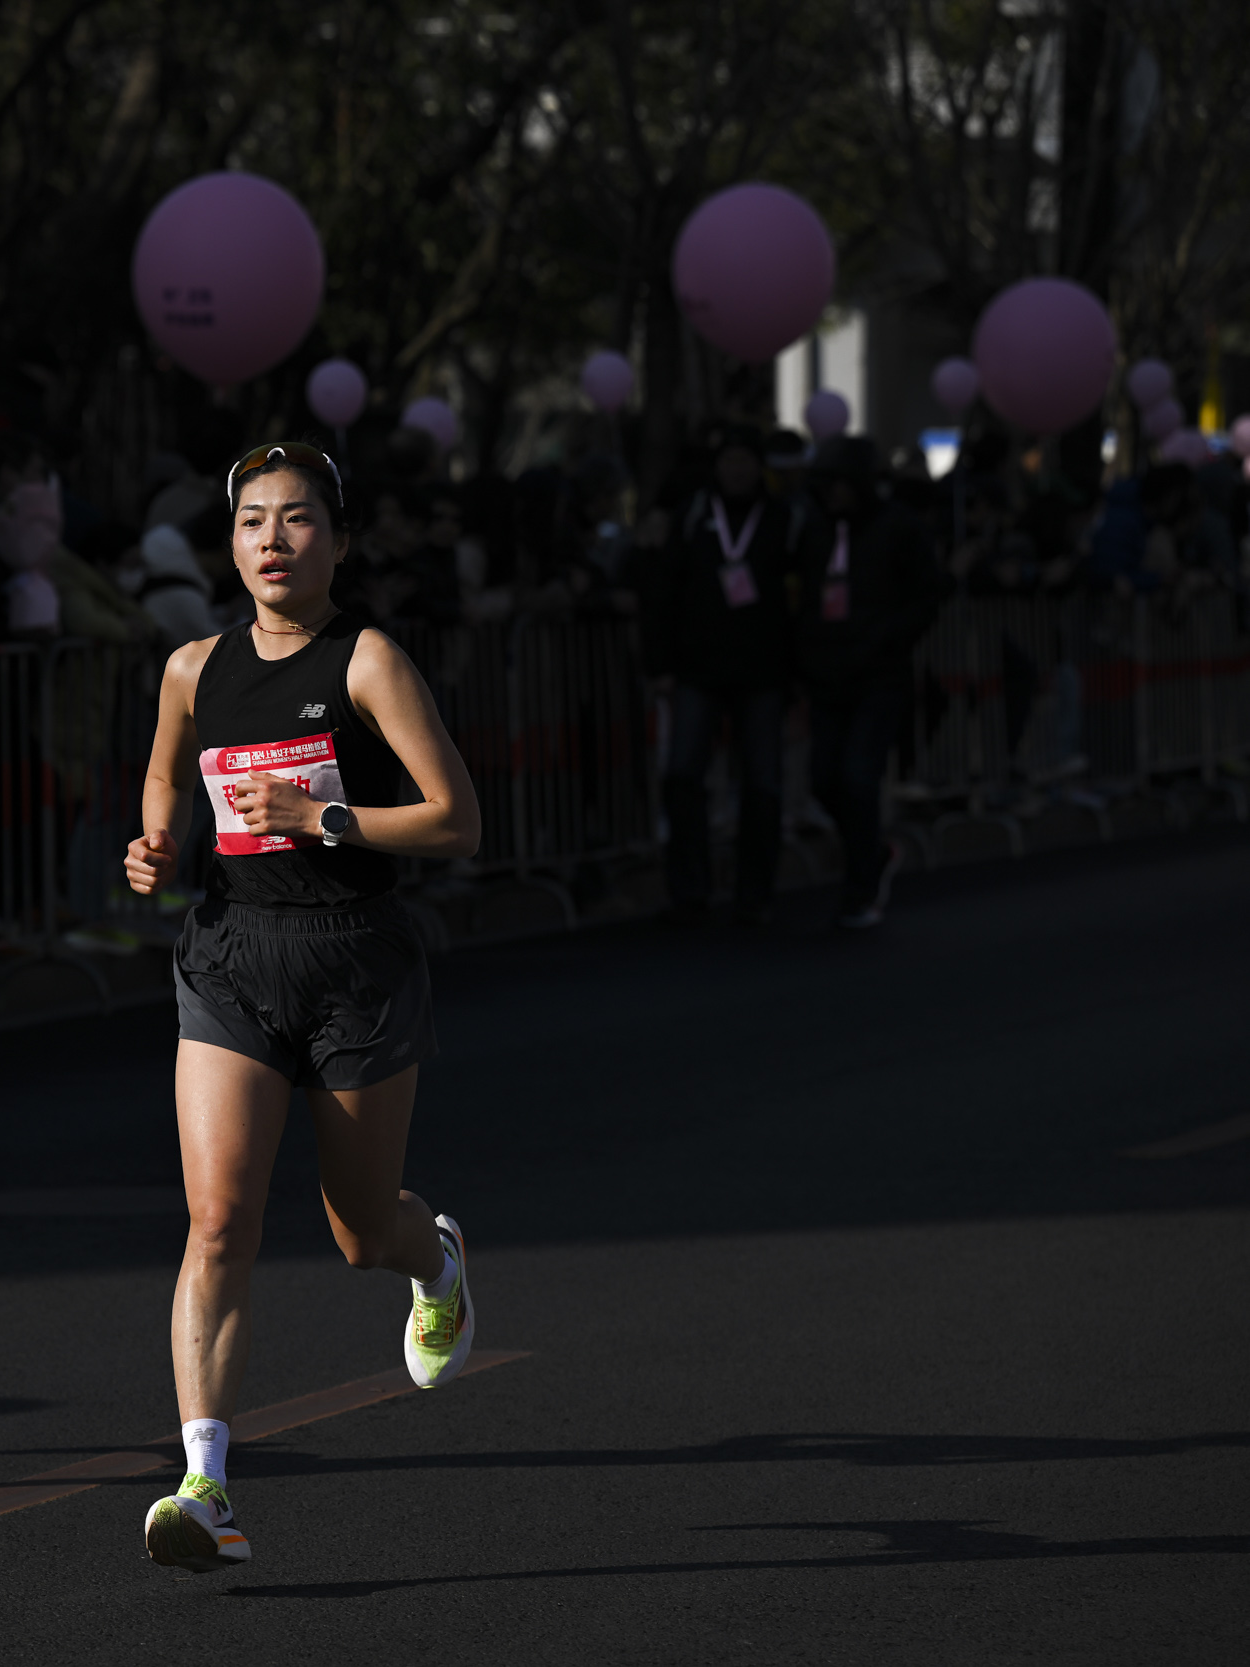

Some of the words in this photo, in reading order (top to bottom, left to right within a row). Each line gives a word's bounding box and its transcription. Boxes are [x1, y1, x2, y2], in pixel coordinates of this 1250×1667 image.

[298, 703, 326, 719] NB
[292, 753, 304, 761] HALF
[303, 748, 330, 759] MARATHON
[189, 1427, 218, 1444] NB
